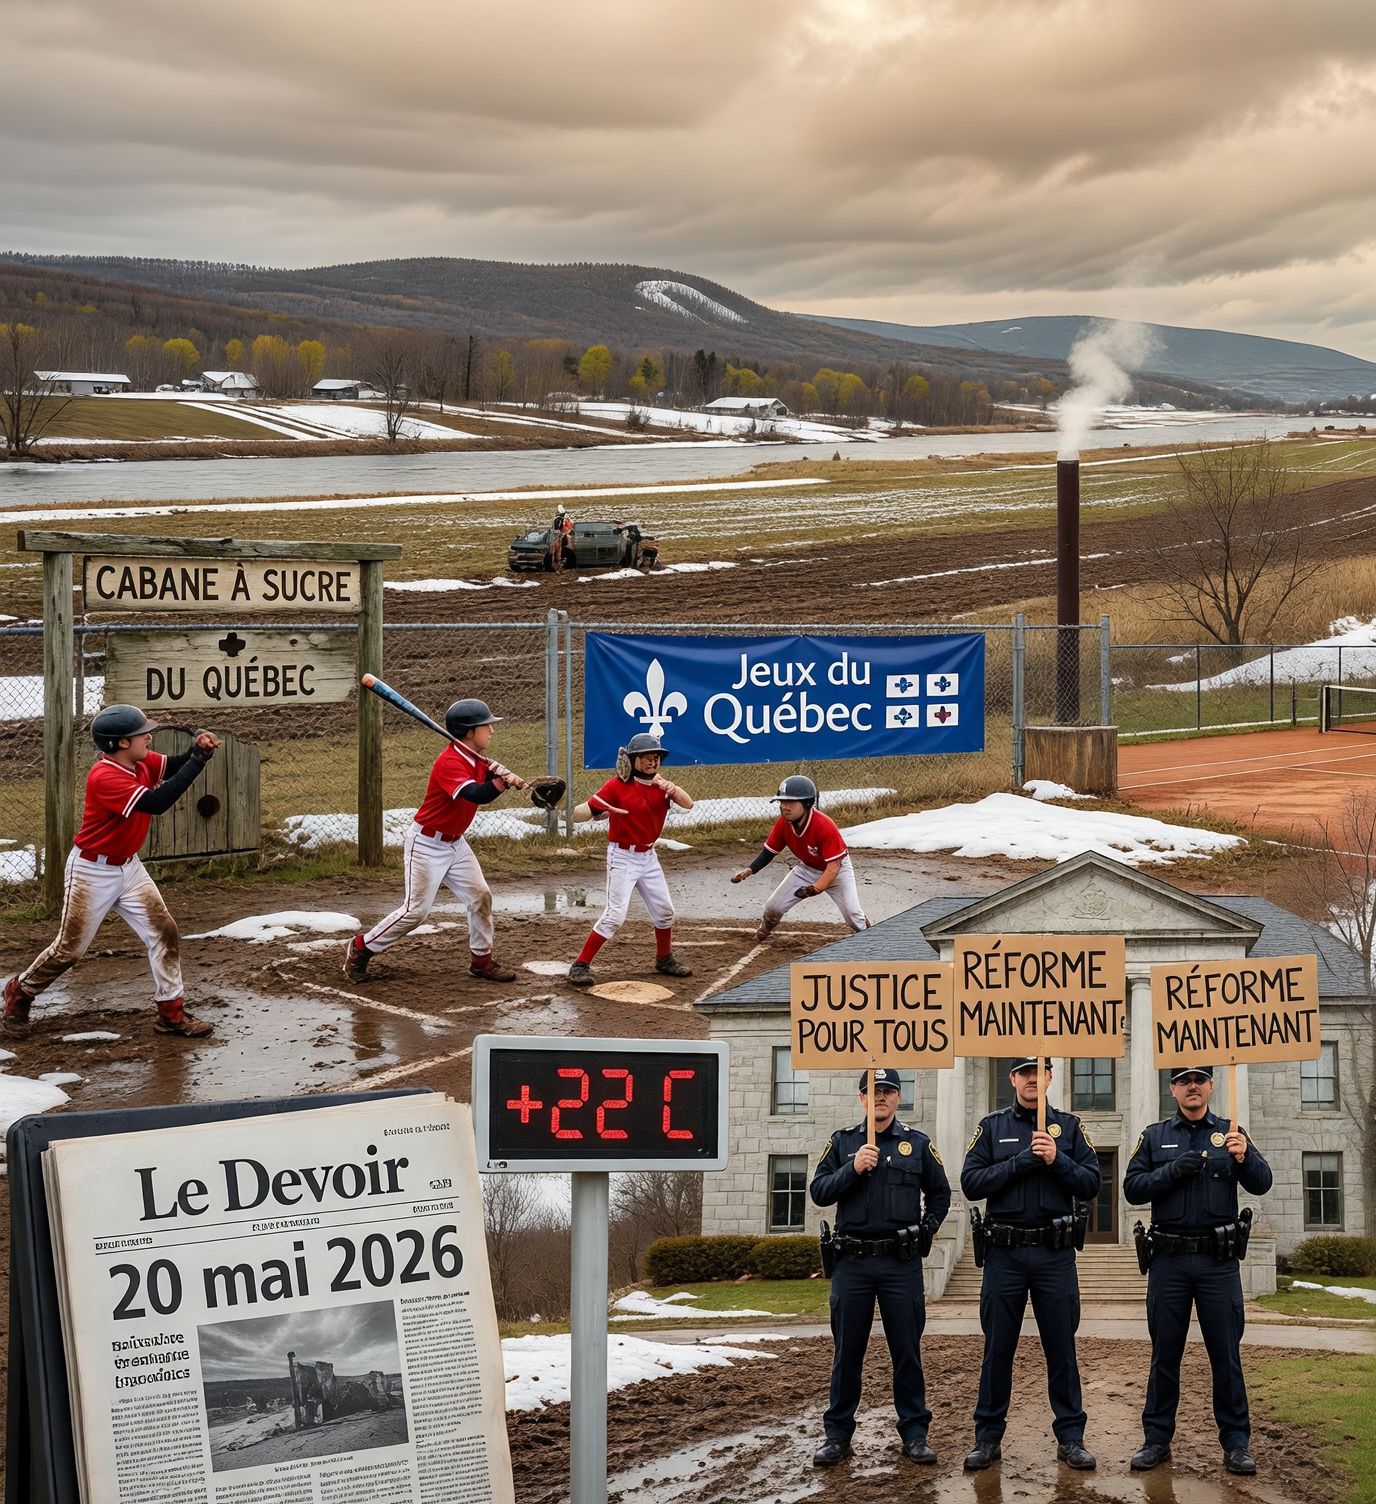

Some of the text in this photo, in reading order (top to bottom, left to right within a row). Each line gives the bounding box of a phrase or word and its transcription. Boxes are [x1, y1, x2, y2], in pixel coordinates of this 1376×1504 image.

[96, 561, 351, 602] CABANE À SUCRE
[147, 656, 316, 700] DU QUÉBEC
[732, 652, 870, 690] Jeux du
[704, 692, 872, 744] Québec
[963, 939, 1107, 989] RÉFORME
[801, 973, 943, 1012] JUSTICE
[1166, 964, 1305, 1010] RÉFORME
[798, 1018, 949, 1054] POUR TOUS
[1157, 1009, 1318, 1054] MAINTENANT
[134, 1144, 409, 1221] Le Devoir
[108, 1224, 464, 1321] 20 mai 2026
